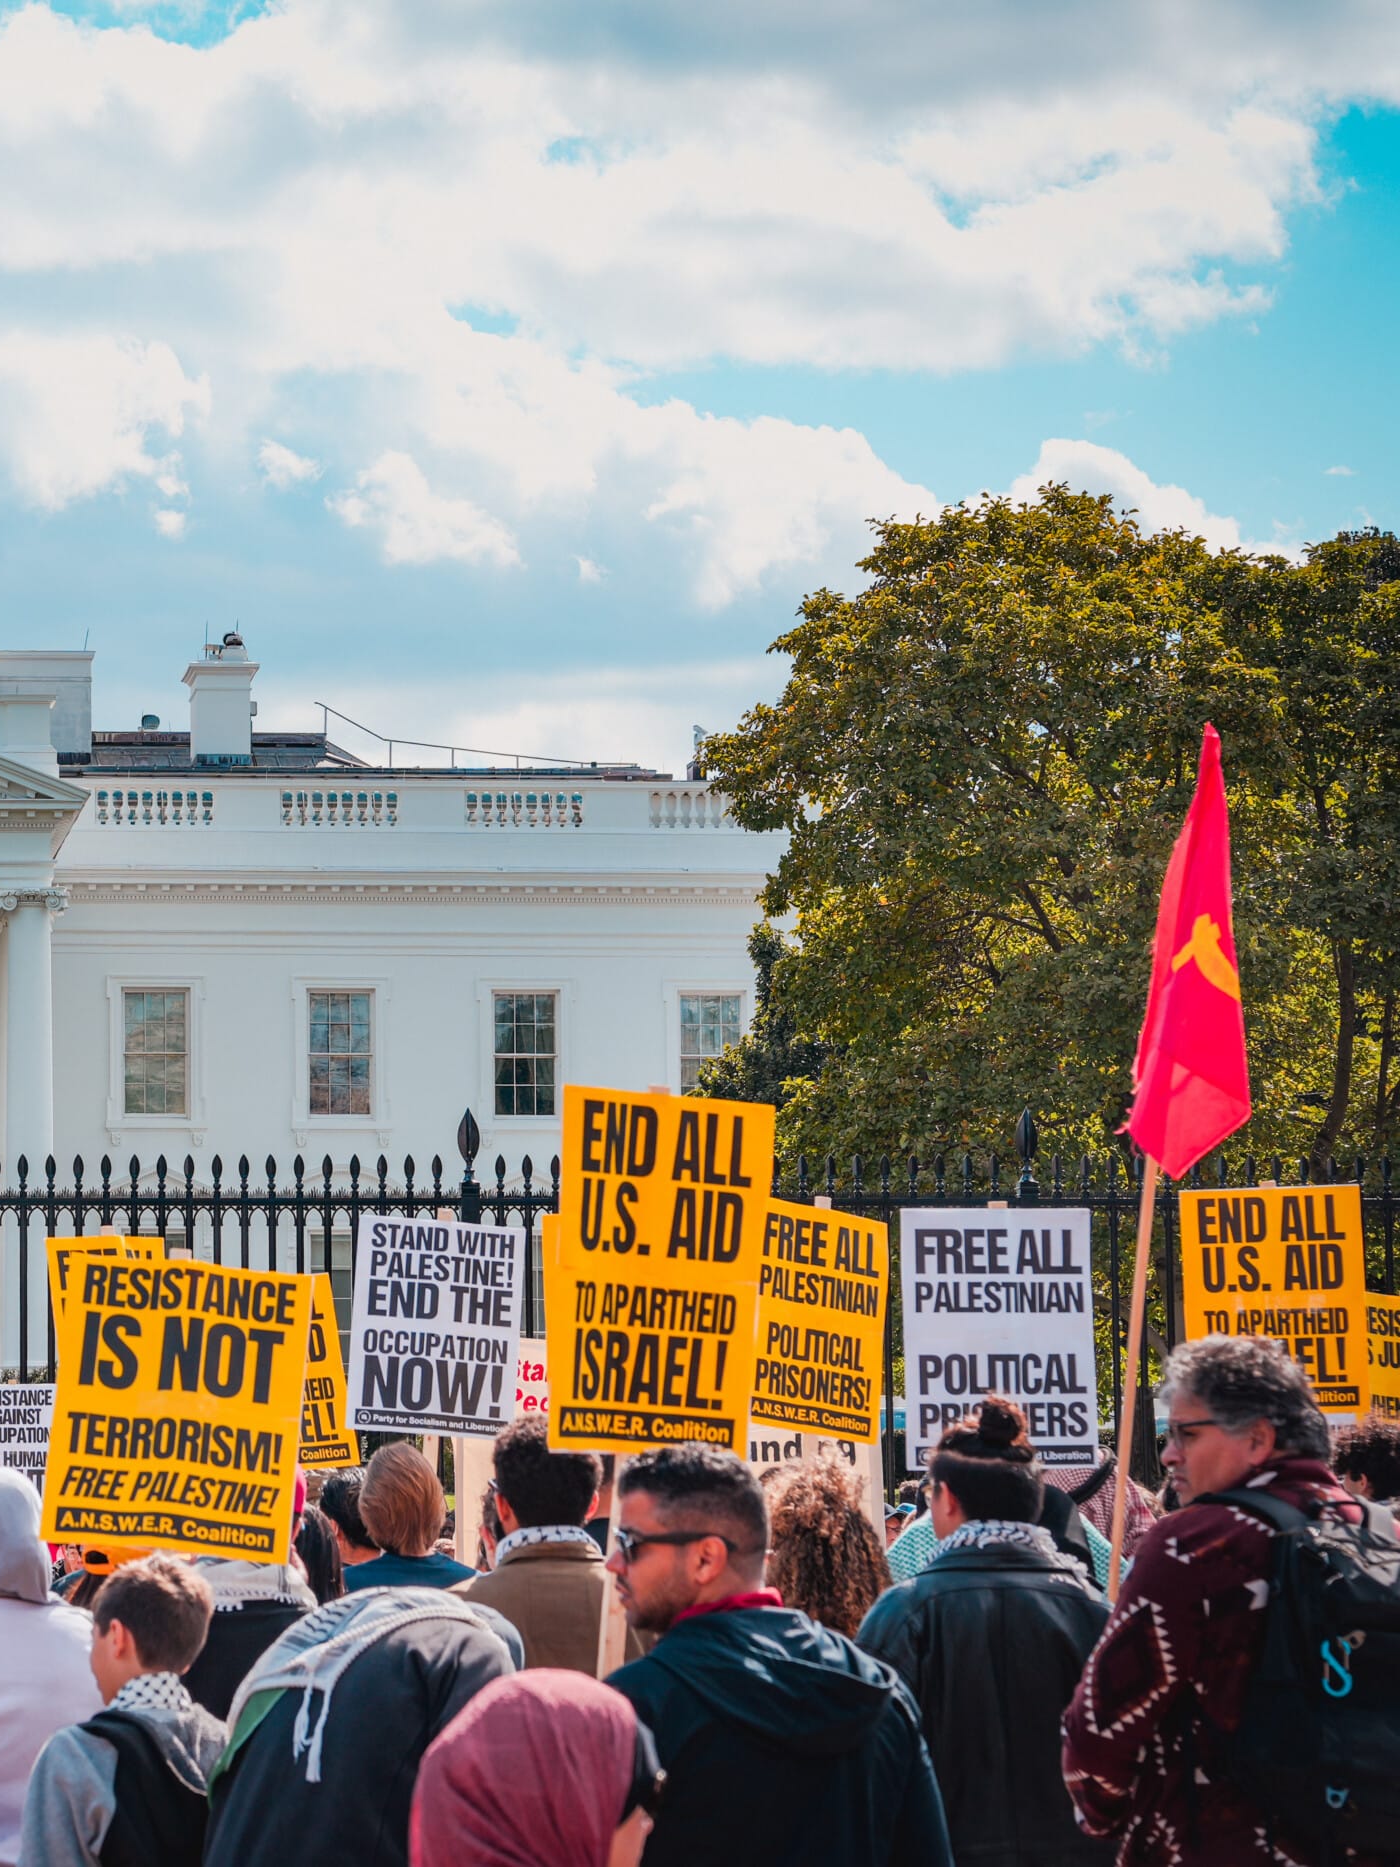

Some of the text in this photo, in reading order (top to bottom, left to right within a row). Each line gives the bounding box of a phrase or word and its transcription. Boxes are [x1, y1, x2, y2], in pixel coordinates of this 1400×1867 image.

[581, 1100, 752, 1187] END ALL
[371, 1223, 515, 1259] STAND WITH
[581, 1178, 743, 1263] U.S. AID
[1197, 1194, 1346, 1244] END ALL
[370, 1251, 513, 1287] PALESTINE!
[762, 1214, 880, 1278] FREE ALL
[915, 1230, 1082, 1274] FREE ALL
[1203, 1244, 1344, 1292] U.S. AID
[83, 1265, 296, 1325] RESISTANCE
[367, 1280, 439, 1319] END
[450, 1285, 513, 1327] THE
[576, 1281, 736, 1335] TO APARTHEID
[759, 1264, 878, 1318] PALESTINIAN
[915, 1281, 1084, 1313] PALESTINIAN
[1204, 1307, 1349, 1336] TO APARTHEID
[79, 1312, 141, 1390] IS
[159, 1317, 284, 1404] NOT
[364, 1329, 507, 1364] OCCUPATION
[572, 1328, 727, 1411] ISRAEL!
[767, 1322, 864, 1372] POLITICAL
[362, 1355, 503, 1418] NOW!
[755, 1359, 872, 1412] PRISONERS!
[919, 1354, 1087, 1396] POLITICAL
[1312, 1391, 1356, 1403] alition
[373, 1414, 394, 1423] Party
[396, 1415, 407, 1423] for
[409, 1416, 447, 1427] Socialism
[561, 1413, 730, 1443] A.N.S.W.E.R. Coalition
[752, 1401, 868, 1432] A.N.S.W.E.R. Coalition
[68, 1412, 282, 1475] TERRORISM!
[301, 1446, 347, 1460] Coalition
[1044, 1450, 1093, 1461] Liberation
[60, 1467, 127, 1501] FREE
[130, 1471, 280, 1516] PALESTINE!
[60, 1512, 270, 1548] A.N.S.W.E.R. Coalition
